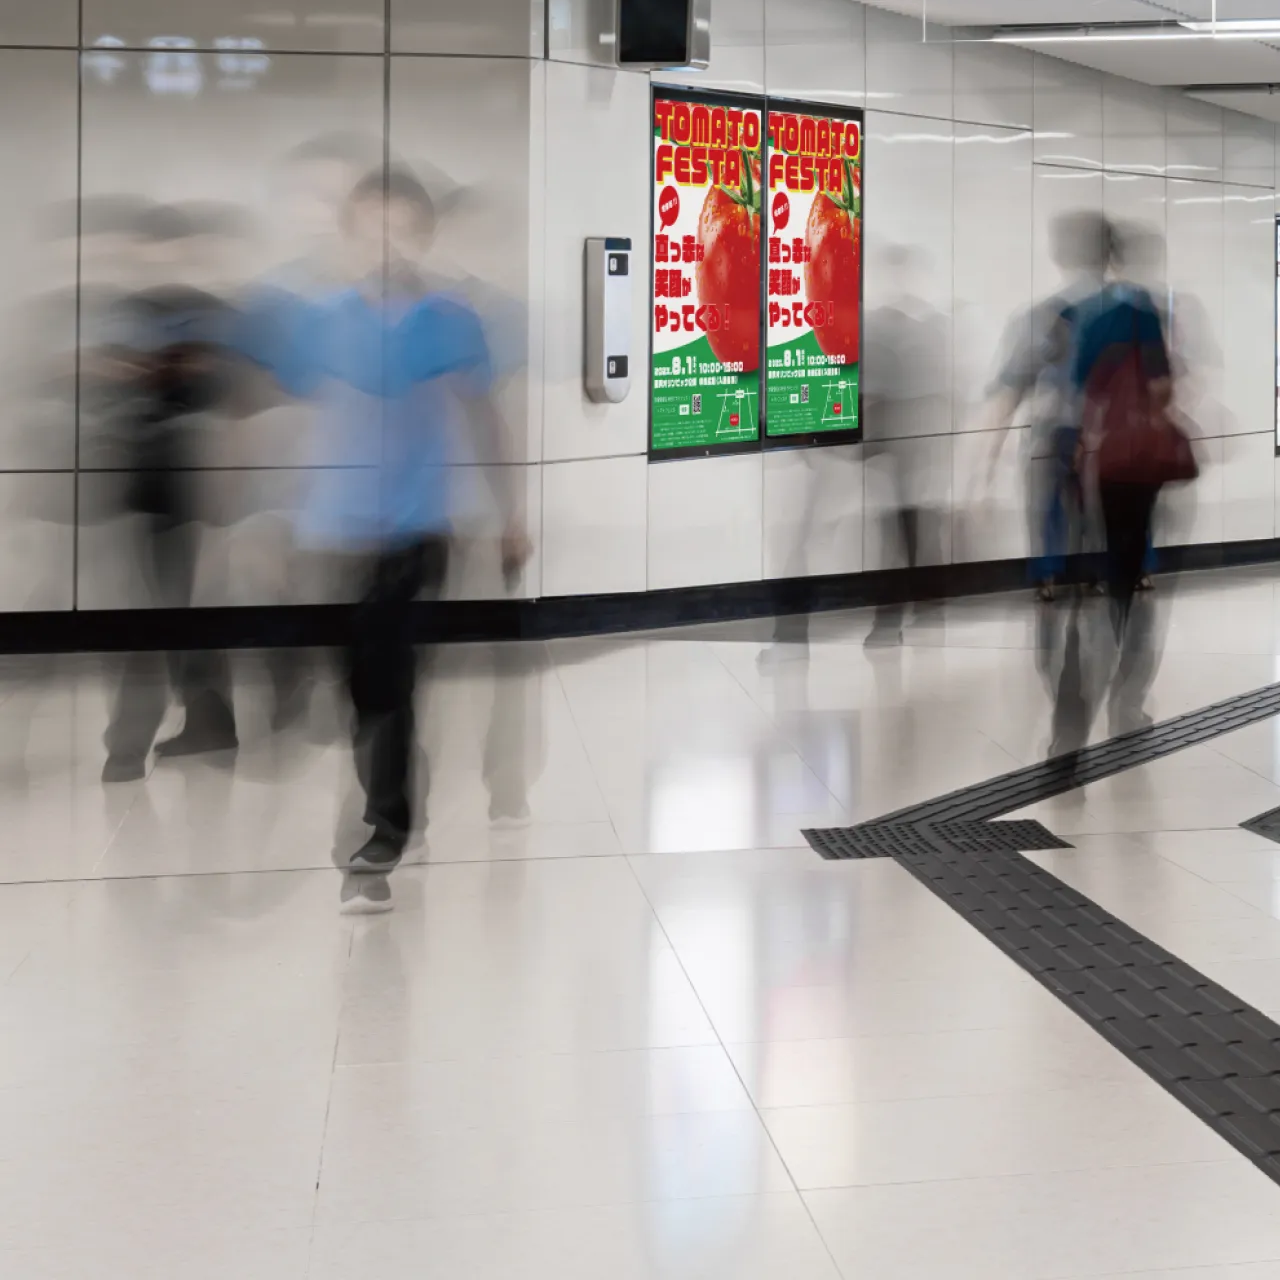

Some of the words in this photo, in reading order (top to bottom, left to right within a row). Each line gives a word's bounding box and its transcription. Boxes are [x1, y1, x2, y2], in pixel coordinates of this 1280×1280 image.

[655, 100, 760, 151] TOMATO
[769, 114, 860, 159] TOMATO
[655, 144, 741, 190] FESTA
[769, 153, 843, 196] FESTA
